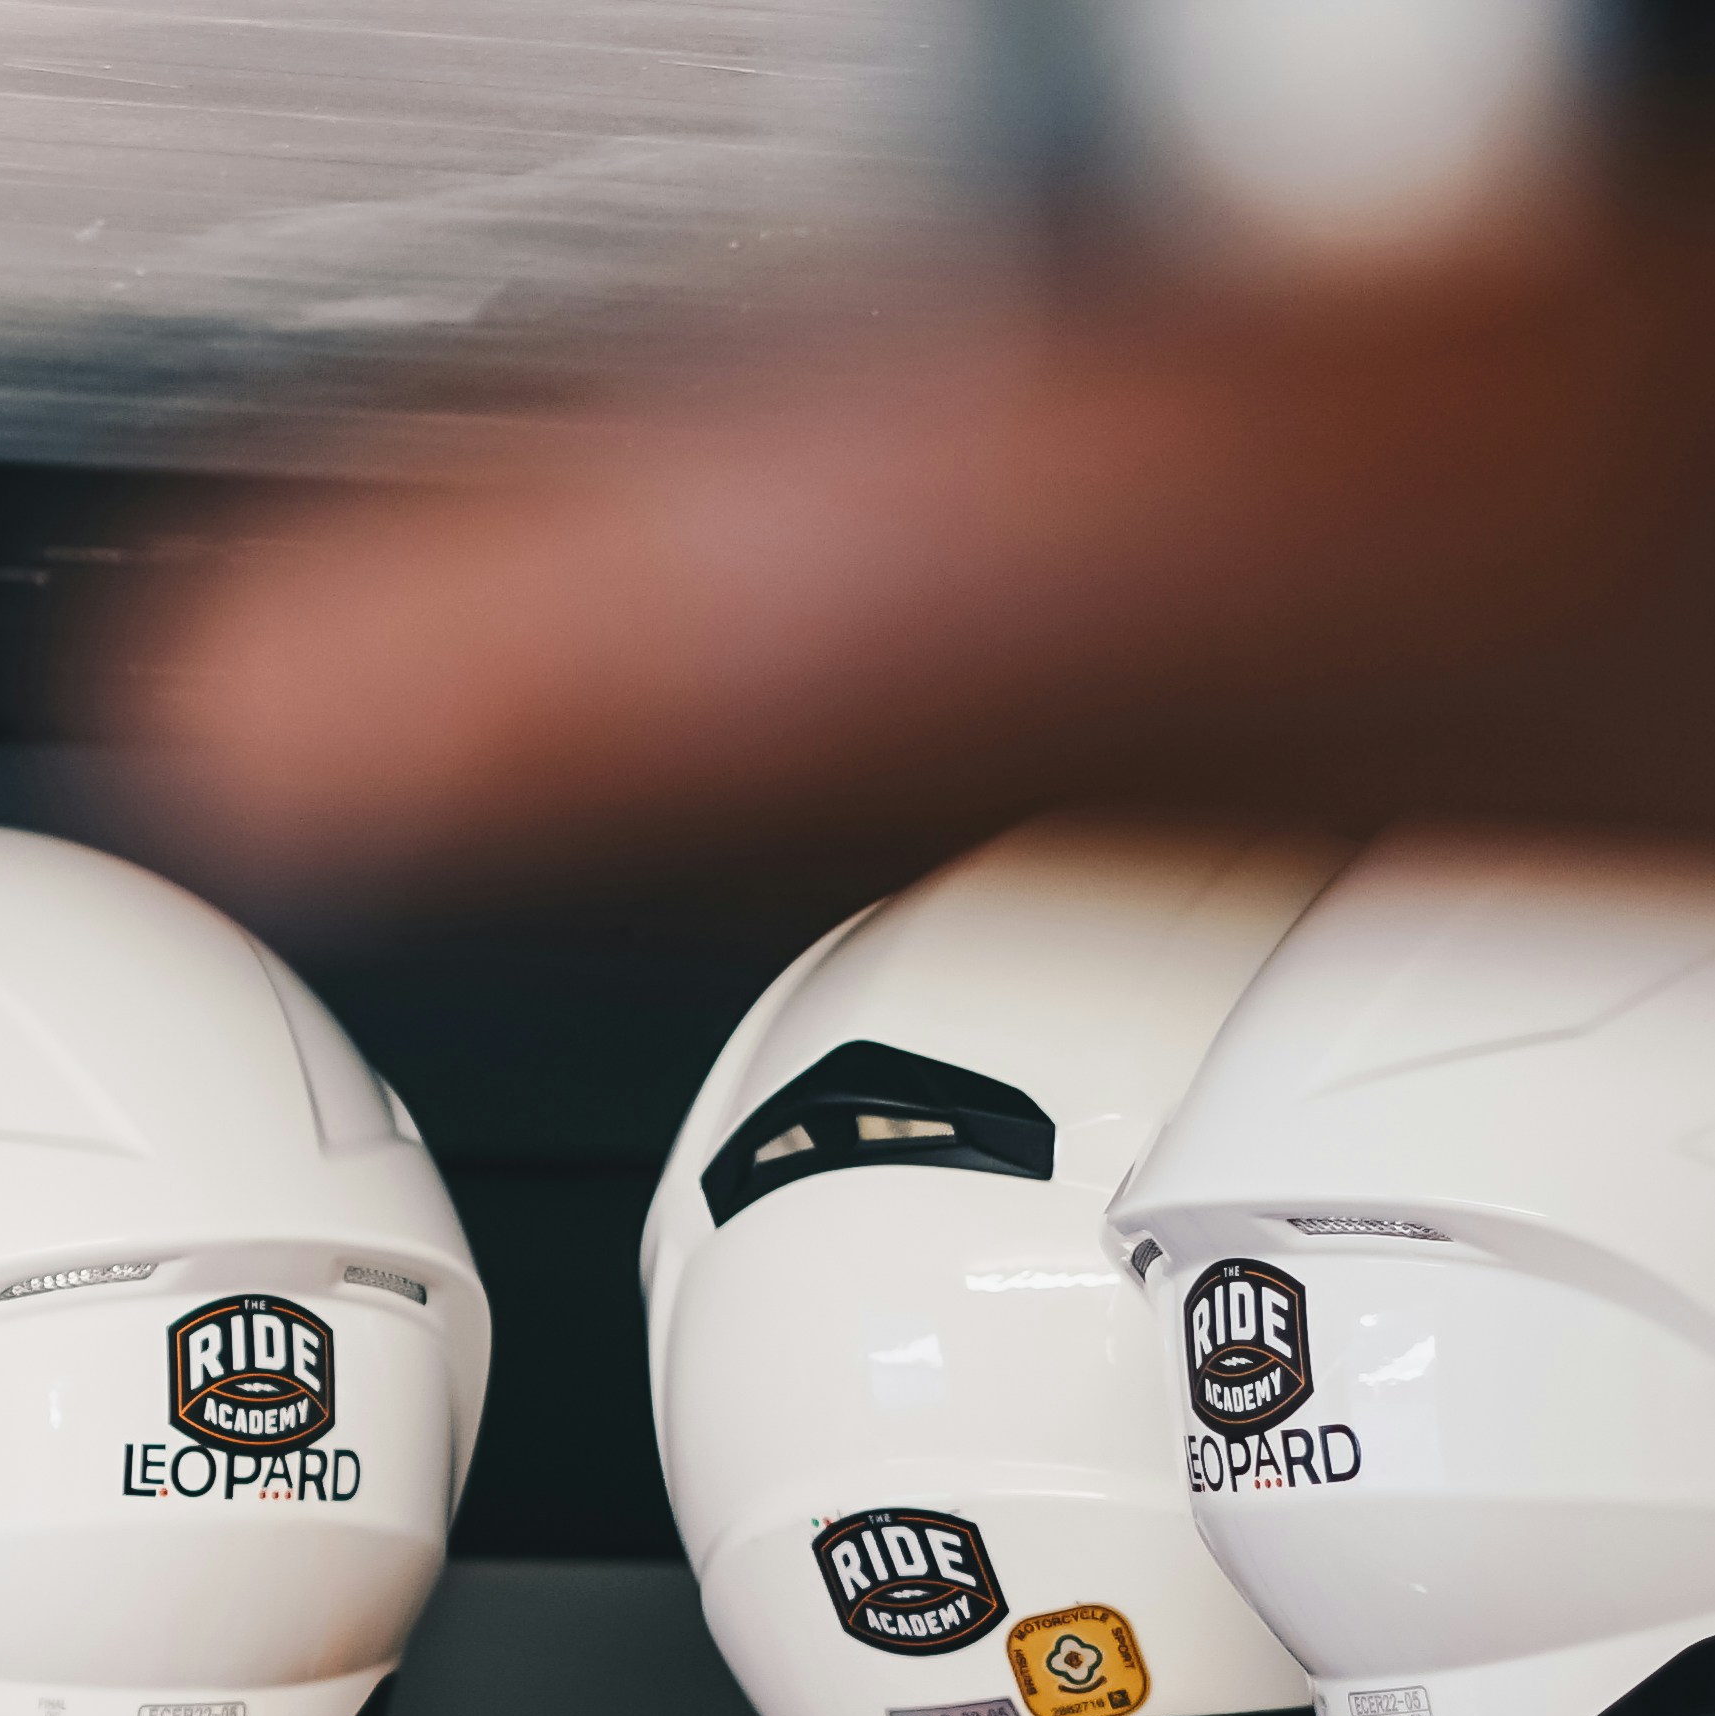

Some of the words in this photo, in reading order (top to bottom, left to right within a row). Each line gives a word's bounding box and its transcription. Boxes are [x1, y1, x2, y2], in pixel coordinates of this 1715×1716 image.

[1223, 1265, 1240, 1278] THE
[244, 1299, 267, 1311] THE
[1192, 1281, 1292, 1370] RIDE
[188, 1314, 321, 1393] RIDE
[204, 1397, 310, 1435] ACADEMY
[1205, 1367, 1281, 1413] ACADEMY
[122, 1443, 361, 1502] LEOPARD
[831, 1526, 976, 1601] RIDE
[866, 1594, 971, 1637] ACADEMY
[1014, 1610, 1110, 1641] MOTORCYCLE
[1111, 1627, 1135, 1669] SPORT
